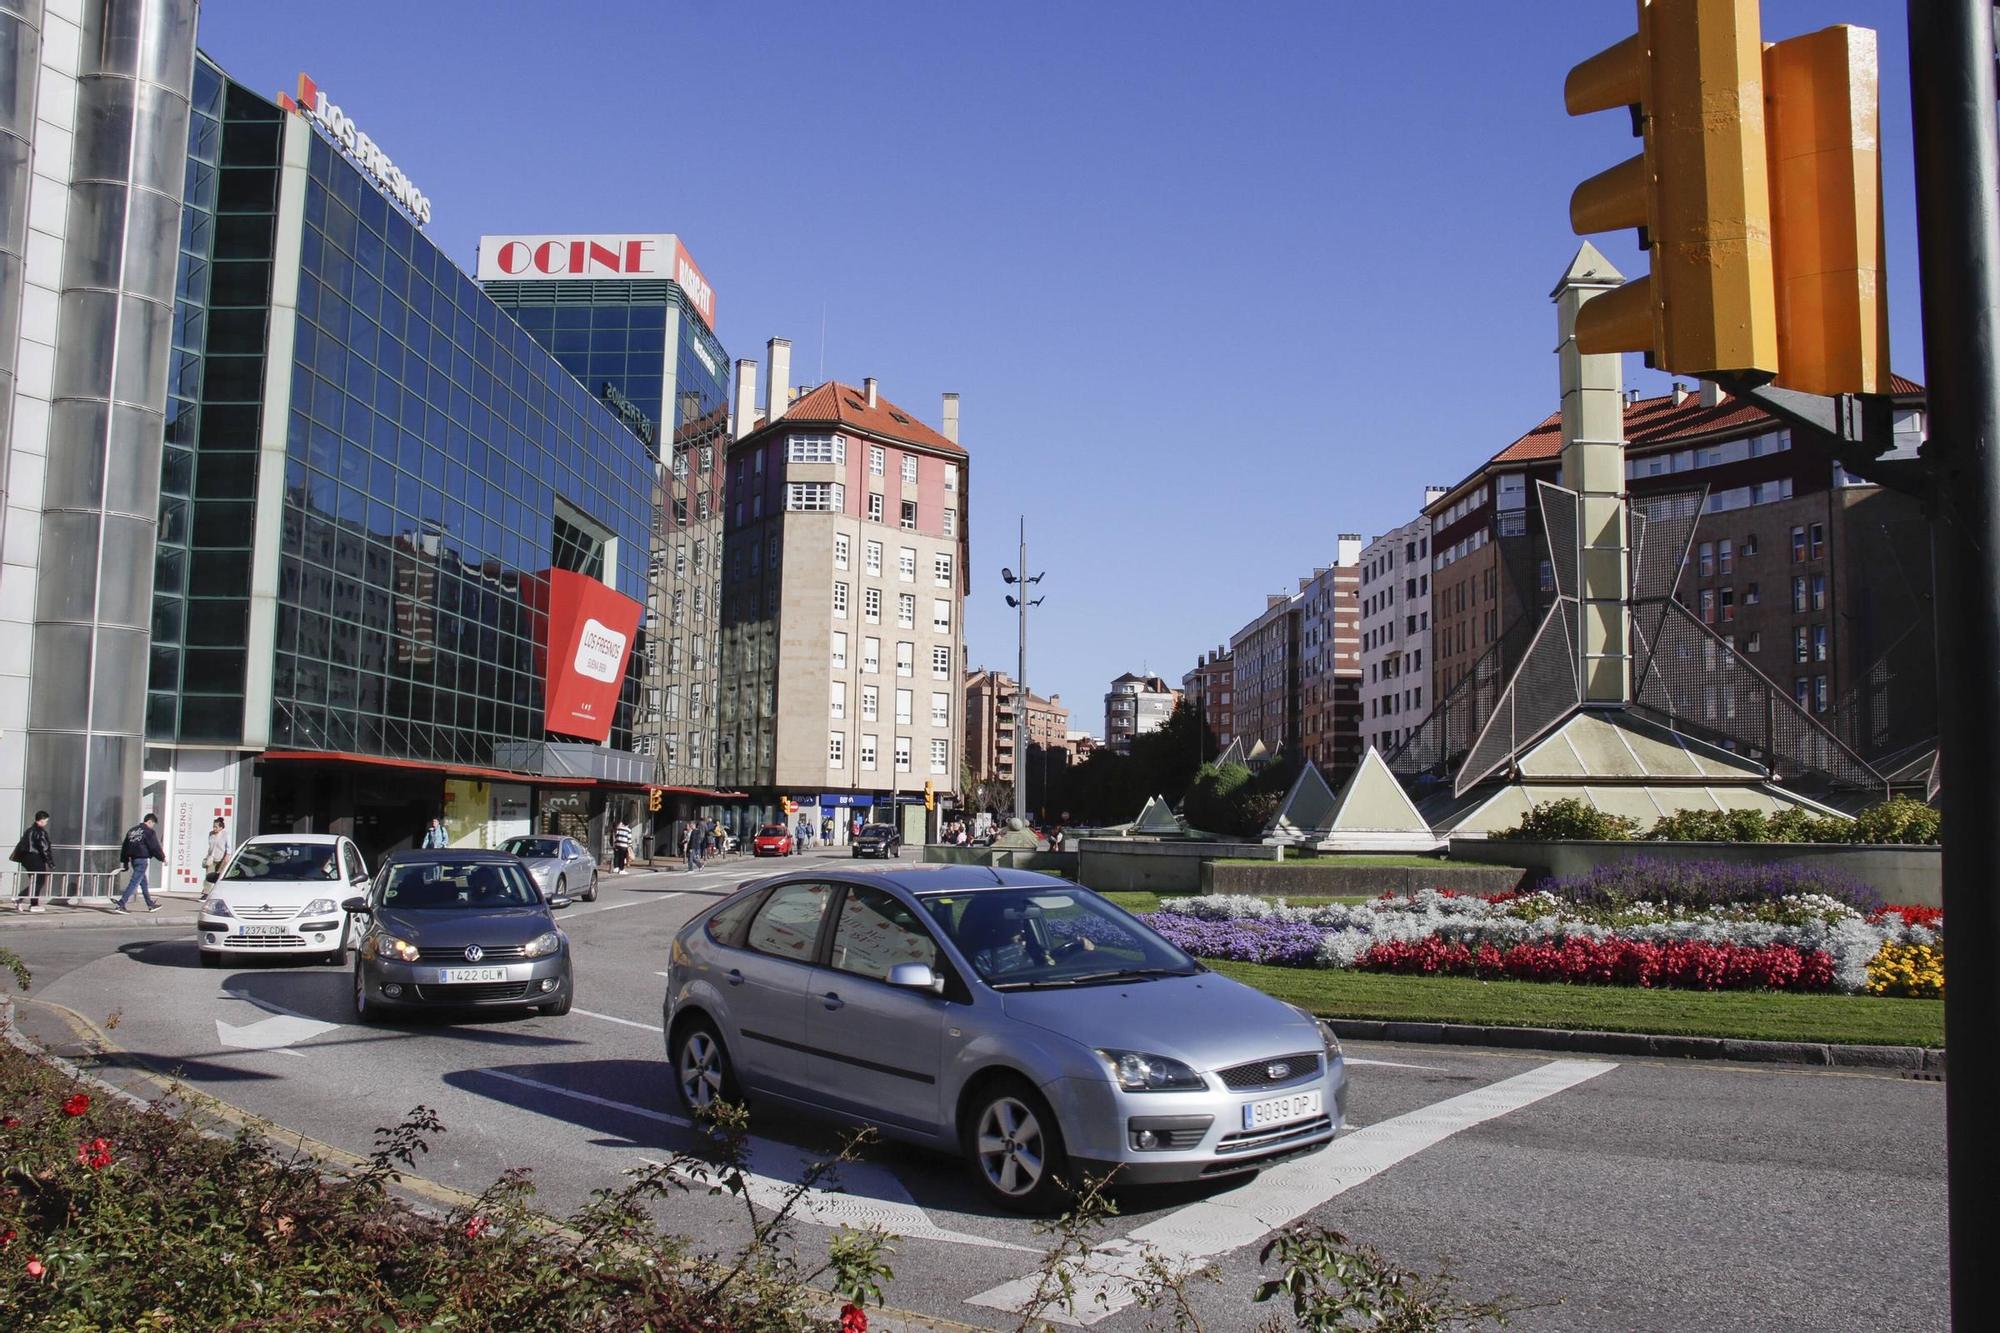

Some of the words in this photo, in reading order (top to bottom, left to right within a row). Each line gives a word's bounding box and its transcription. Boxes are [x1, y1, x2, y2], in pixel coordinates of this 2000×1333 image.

[315, 91, 356, 149] LOS
[354, 132, 431, 224] FRESNOS
[497, 240, 655, 274] OCINE
[584, 631, 597, 649] LOS
[595, 636, 620, 659] FRESNOS
[839, 796, 854, 804] BBVA
[178, 802, 187, 845] FRESNOS
[245, 926, 267, 935] 2374
[269, 926, 287, 935] CDM
[451, 969, 478, 981] 1422
[482, 969, 503, 981] GLW
[1255, 1099, 1289, 1123] 9039
[1294, 1093, 1318, 1115] DPJ
